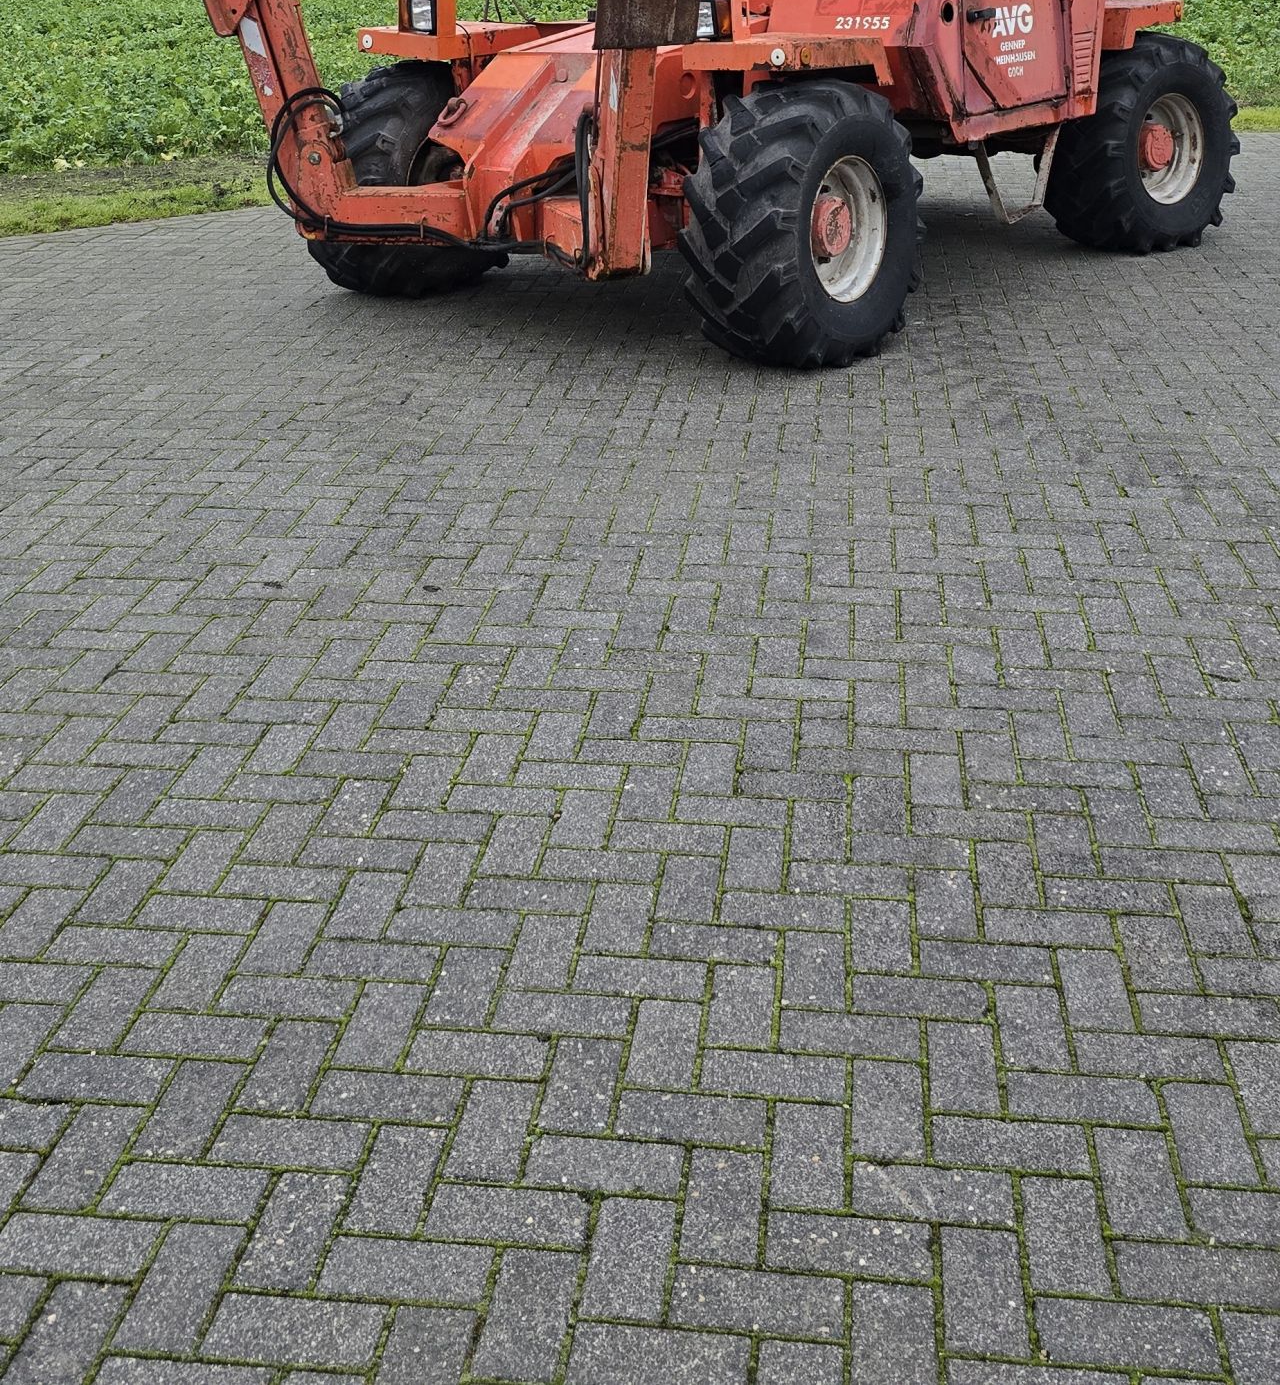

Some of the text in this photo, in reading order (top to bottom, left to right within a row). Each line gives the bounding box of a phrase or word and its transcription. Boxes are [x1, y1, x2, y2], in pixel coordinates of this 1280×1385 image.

[834, 16, 890, 29] 231955
[992, 3, 1033, 38] AVG
[1000, 39, 1026, 51] GENNEP
[994, 51, 1036, 65] HEINHAUSEN
